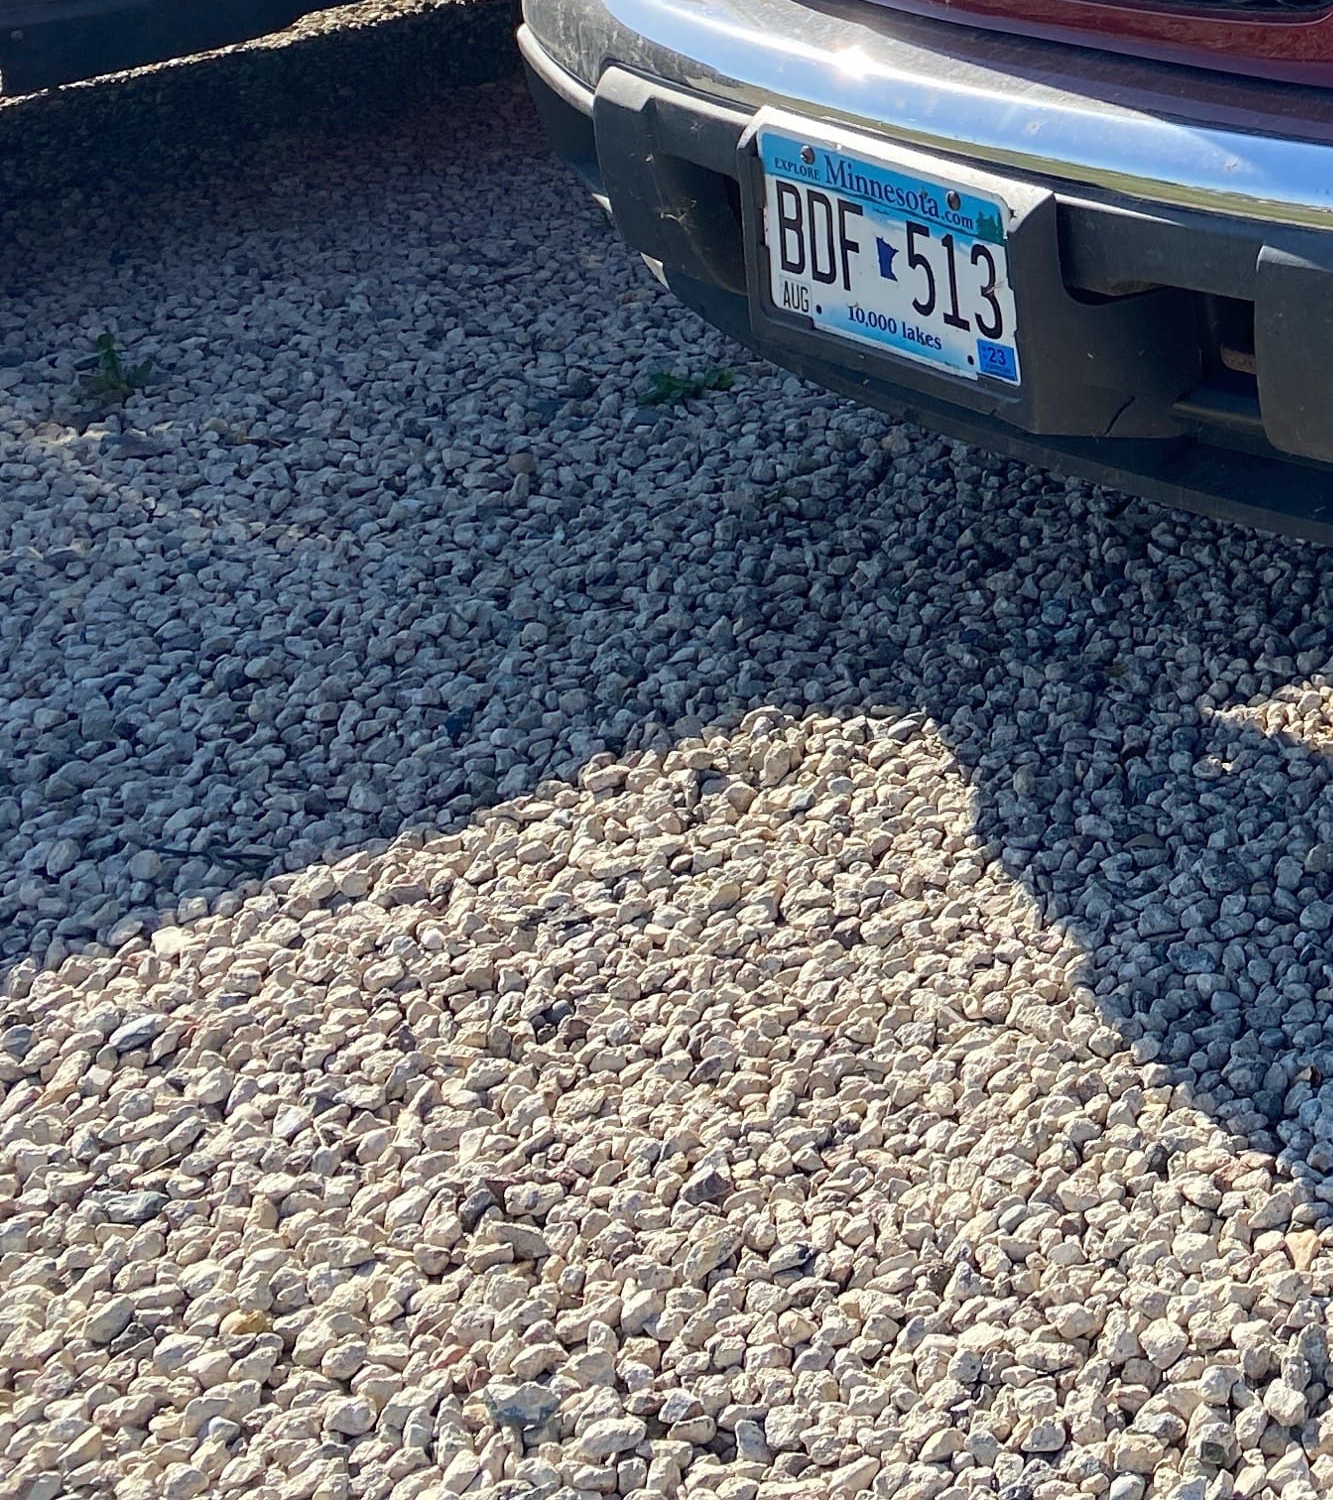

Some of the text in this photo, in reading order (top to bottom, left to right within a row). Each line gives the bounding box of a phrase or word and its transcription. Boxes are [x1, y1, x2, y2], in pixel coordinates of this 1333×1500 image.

[774, 157, 821, 181] EXPLORE
[776, 180, 1003, 340] BDF 513
[783, 280, 810, 313] AUG
[848, 304, 943, 350] 10,000 lakes
[987, 346, 1007, 366] 23
